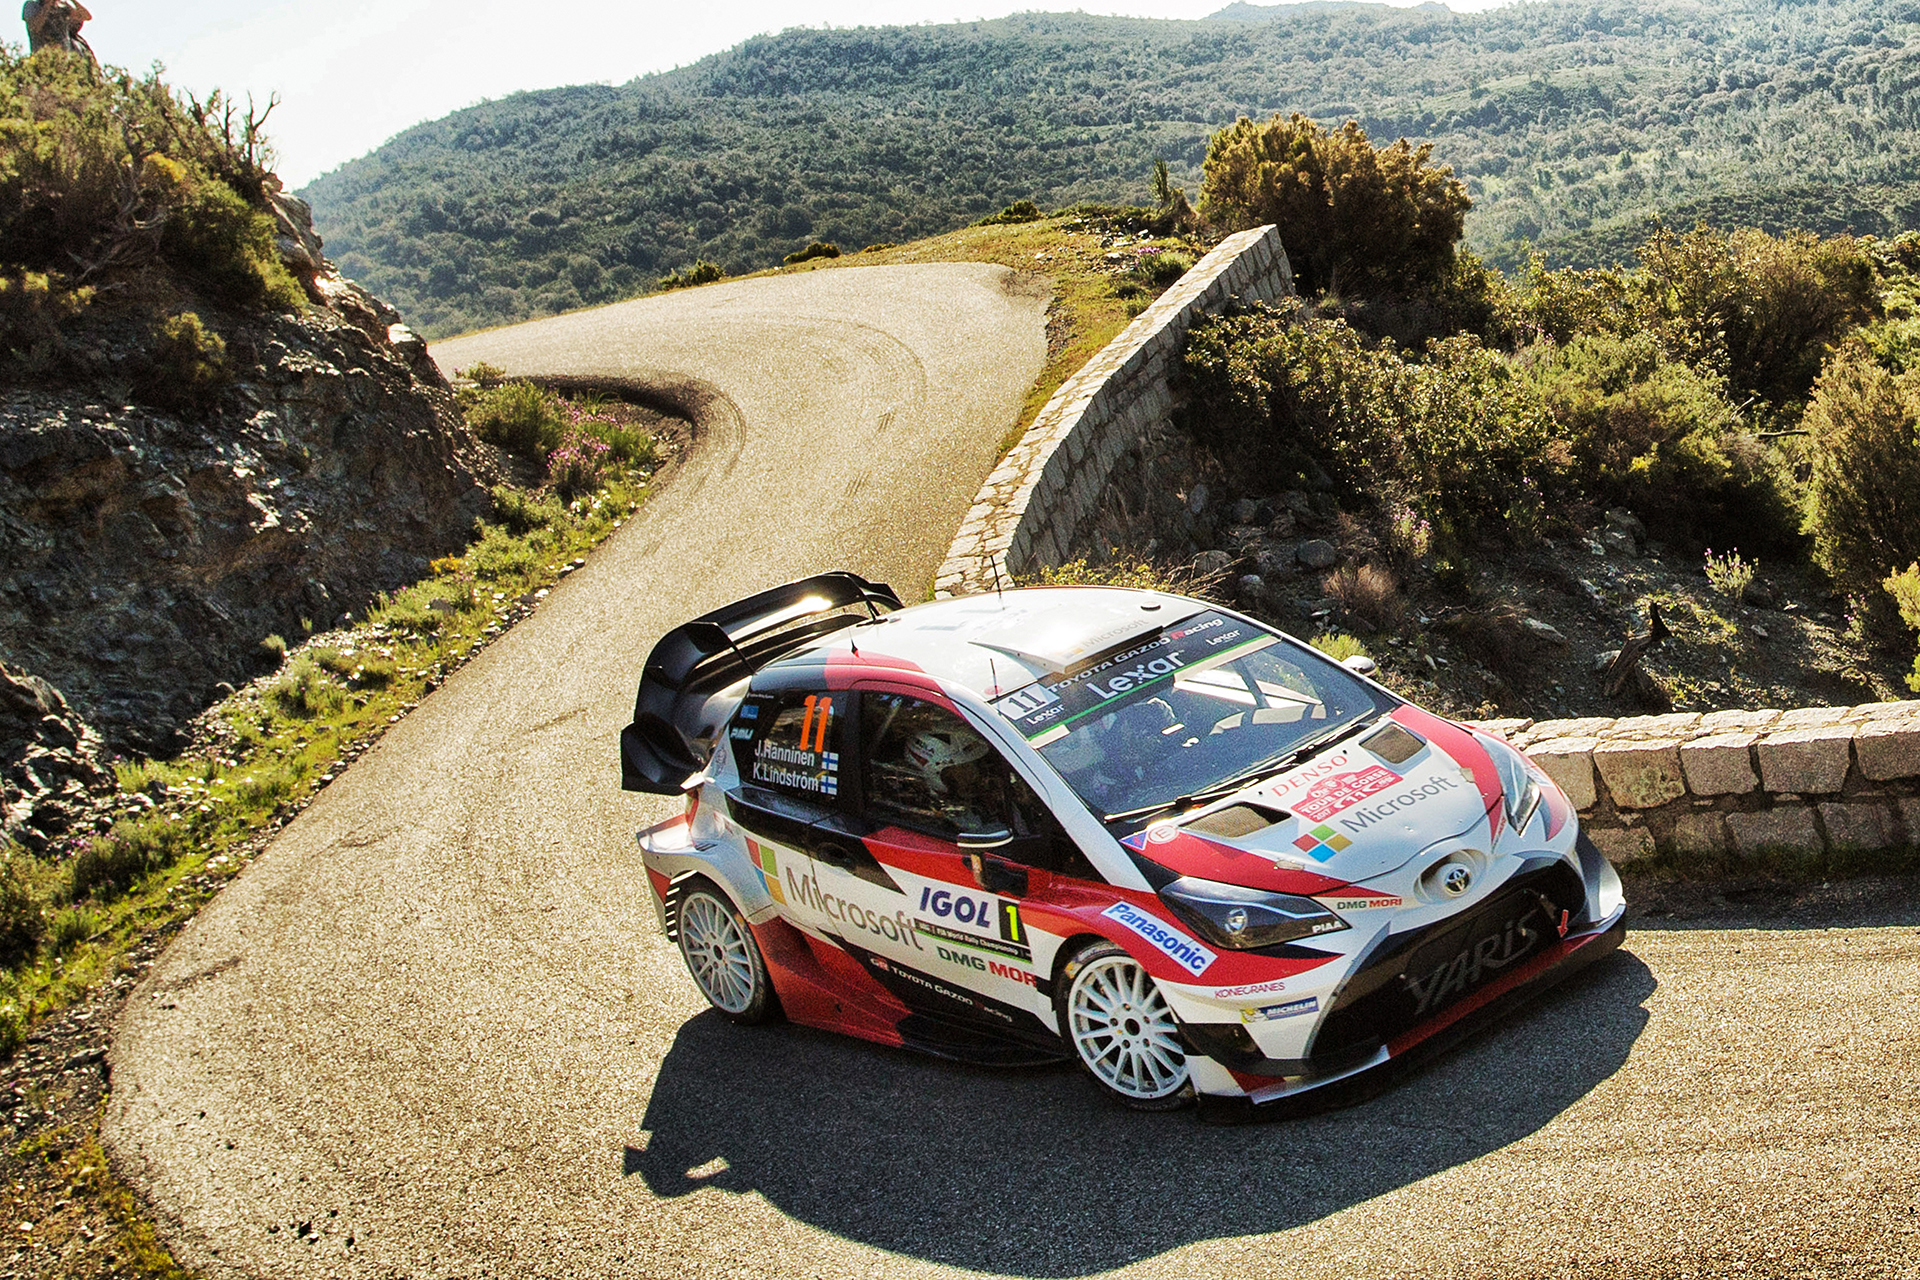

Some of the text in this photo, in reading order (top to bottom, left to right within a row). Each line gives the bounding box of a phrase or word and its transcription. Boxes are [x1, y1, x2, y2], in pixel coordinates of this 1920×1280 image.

[1082, 618, 1150, 648] Microsoft
[1205, 628, 1241, 646] Lexar
[1048, 617, 1225, 692] TOYOTA GAZOO Racing
[1086, 652, 1185, 700] Lexar
[1008, 690, 1046, 714] 11
[1027, 703, 1065, 725] Lexar
[800, 694, 832, 753] 11
[754, 740, 815, 767] J.Hänninen
[753, 762, 819, 792] K.Lindström
[1272, 755, 1348, 797] DENSO
[1300, 794, 1336, 814] TOUR
[1332, 786, 1352, 798] DE
[1351, 769, 1389, 789] CORSE
[1312, 808, 1332, 821] 2017
[1339, 774, 1459, 833] Microsoft
[786, 866, 924, 952] Microsoft
[920, 887, 991, 928] IGOL
[1336, 898, 1402, 910] DMG MORI
[1005, 905, 1020, 941] 1
[1108, 903, 1206, 970] Panasonic
[1312, 921, 1343, 934] PIAA
[937, 946, 1037, 988] DMG MOR
[890, 965, 933, 989] TOYOTA
[934, 984, 973, 1006] GAZOO
[1214, 982, 1286, 999] KONECRANES
[1267, 1000, 1317, 1016] MICHELIN
